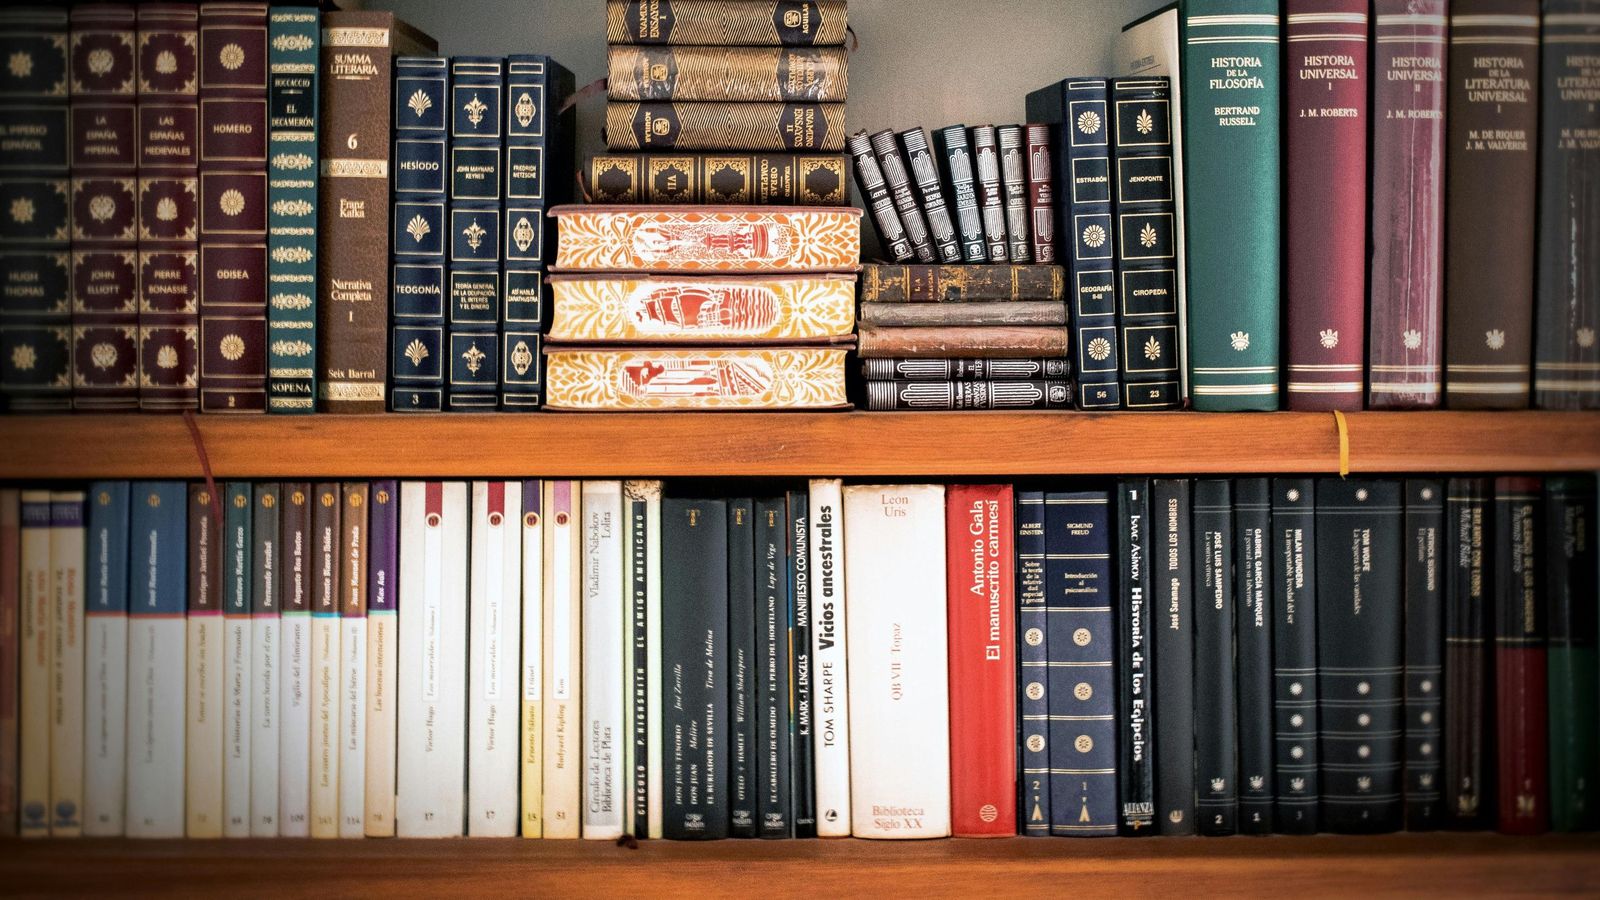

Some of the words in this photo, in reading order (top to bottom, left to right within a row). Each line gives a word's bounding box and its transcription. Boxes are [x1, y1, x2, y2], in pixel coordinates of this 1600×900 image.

[335, 54, 371, 64] SUMMA
[1212, 57, 1262, 68] HISTORIA
[1304, 56, 1354, 67] HISTORIA
[1392, 57, 1441, 68] HISTORIA
[1473, 57, 1524, 68] HISTORIA
[330, 64, 378, 75] LITERARIA
[1227, 69, 1237, 77] DE
[1238, 69, 1247, 77] LA
[1300, 69, 1358, 80] UNIVERSAL
[1387, 70, 1443, 82] UNIVERSAL
[1489, 69, 1499, 77] DE
[1500, 69, 1510, 77] LA
[1210, 77, 1264, 90] FILOSOFÍA
[1465, 78, 1531, 91] LITERATURA
[1468, 91, 1528, 102] UNIVERSAL
[286, 104, 297, 114] EL
[1215, 106, 1260, 116] BERTRAND
[1300, 109, 1307, 118] J.
[1308, 109, 1319, 118] M.
[1320, 108, 1358, 118] ROBERTS
[95, 116, 106, 125] LA
[159, 117, 174, 126] LAS
[271, 116, 314, 127] DECAMERÓN
[795, 108, 803, 148] ENSAYOS
[805, 108, 813, 147] UNAMUNO
[1219, 117, 1256, 126] RUSSELL
[86, 129, 118, 140] ESPAÑA
[150, 129, 185, 141] ESPAÑAS
[213, 124, 252, 134] HOMERO
[1469, 130, 1480, 140] M.
[1481, 130, 1494, 140] DE
[1495, 130, 1526, 141] RIQUER
[347, 133, 358, 150] 6
[401, 159, 439, 171] HESÍODO
[667, 174, 676, 190] VII
[770, 167, 778, 196] OBRAS
[1129, 175, 1163, 183] JENOFONTE
[339, 199, 365, 209] Franz
[339, 207, 365, 218] Kafka
[91, 271, 115, 281] JOHN
[154, 270, 181, 279] PIERRE
[216, 269, 249, 280] ODISEA
[331, 279, 372, 290] Narrativa
[396, 284, 441, 295] TEOGONÍA
[1081, 284, 1112, 293] GEOGRAFÍA
[1133, 288, 1167, 296] CIROPEDIA
[331, 290, 372, 303] Completa
[328, 369, 345, 379] Seix
[348, 368, 375, 379] Barral
[272, 383, 312, 393] SOPENA
[1150, 390, 1160, 398] 23
[412, 394, 419, 404] 3
[1129, 490, 1138, 500] 1
[884, 507, 907, 517] Uris
[969, 500, 984, 535] Gala
[1168, 499, 1177, 532] NOMBRES
[601, 512, 611, 538] Lolita
[985, 500, 999, 558] carmesí
[589, 512, 599, 554] Nabokov
[1168, 534, 1177, 547] LOS
[1204, 531, 1212, 540] La
[1294, 529, 1302, 552] MILAN
[1362, 529, 1370, 545] TOM
[635, 514, 644, 582] AMERICANO
[768, 543, 776, 559] Vega
[795, 517, 807, 571] COMUNISTA
[816, 505, 833, 597] ancestrales
[1254, 528, 1262, 560] GABRIEL
[351, 548, 359, 559] de
[1168, 548, 1178, 571] TODOS
[1214, 550, 1222, 567] LUIS
[1362, 547, 1370, 572] WOLFE
[351, 559, 359, 586] Manuel
[768, 562, 775, 570] de
[969, 540, 985, 596] Antonio
[1294, 553, 1303, 588] KUNDERA
[377, 570, 385, 586] Aub
[589, 557, 599, 598] Vladimir
[1254, 561, 1263, 588] GARCÍA
[768, 577, 777, 589] Lope
[1214, 568, 1223, 609] SAMPEDRO
[351, 588, 359, 606] Juan
[797, 572, 808, 626] MANIFIESTO
[985, 560, 1000, 640] manuscrito
[1169, 578, 1180, 612] Saramago
[636, 591, 644, 627] AMIGO
[1253, 590, 1263, 627] MÁRQUEZ
[768, 596, 776, 640] HORTELANO
[1169, 614, 1179, 630] José
[818, 602, 834, 651] Vicios
[636, 637, 644, 648] EL
[705, 629, 713, 657] Molina
[891, 623, 903, 653] Topaz
[985, 645, 1000, 660] El
[705, 660, 713, 668] de
[737, 648, 747, 691] Shakespeare
[798, 654, 808, 685] ENGELS
[891, 663, 901, 679] VII
[674, 664, 682, 694] Zorrilla
[769, 683, 776, 691] EL
[822, 662, 834, 713] SHARPE
[891, 683, 903, 700] QB
[674, 696, 683, 711] José
[737, 693, 745, 722] William
[557, 705, 566, 732] Kipling
[706, 703, 714, 735] SEVILLA
[800, 701, 809, 725] MARX
[601, 727, 611, 750] Plata
[800, 727, 809, 735] K.
[824, 720, 834, 747] TOM
[589, 720, 600, 759] Lectores
[707, 737, 714, 748] DE
[770, 740, 776, 750] DE
[557, 734, 566, 768] Rudyard
[737, 733, 745, 762] HAMLET
[601, 752, 611, 764] de
[589, 763, 600, 774] de
[675, 764, 683, 784] JUAN
[690, 764, 699, 784] JUAN
[601, 767, 612, 813] Biblioteca
[737, 775, 745, 800] OTELO
[1032, 781, 1040, 790] 2
[589, 777, 600, 813] Círculo
[675, 786, 683, 804] DON
[690, 786, 698, 804] DON
[707, 796, 714, 804] EL
[770, 794, 777, 803] EL
[872, 806, 924, 816] Biblioteca
[874, 818, 899, 831] Siglo
[904, 818, 922, 828] XX
[1215, 814, 1223, 824] 2
